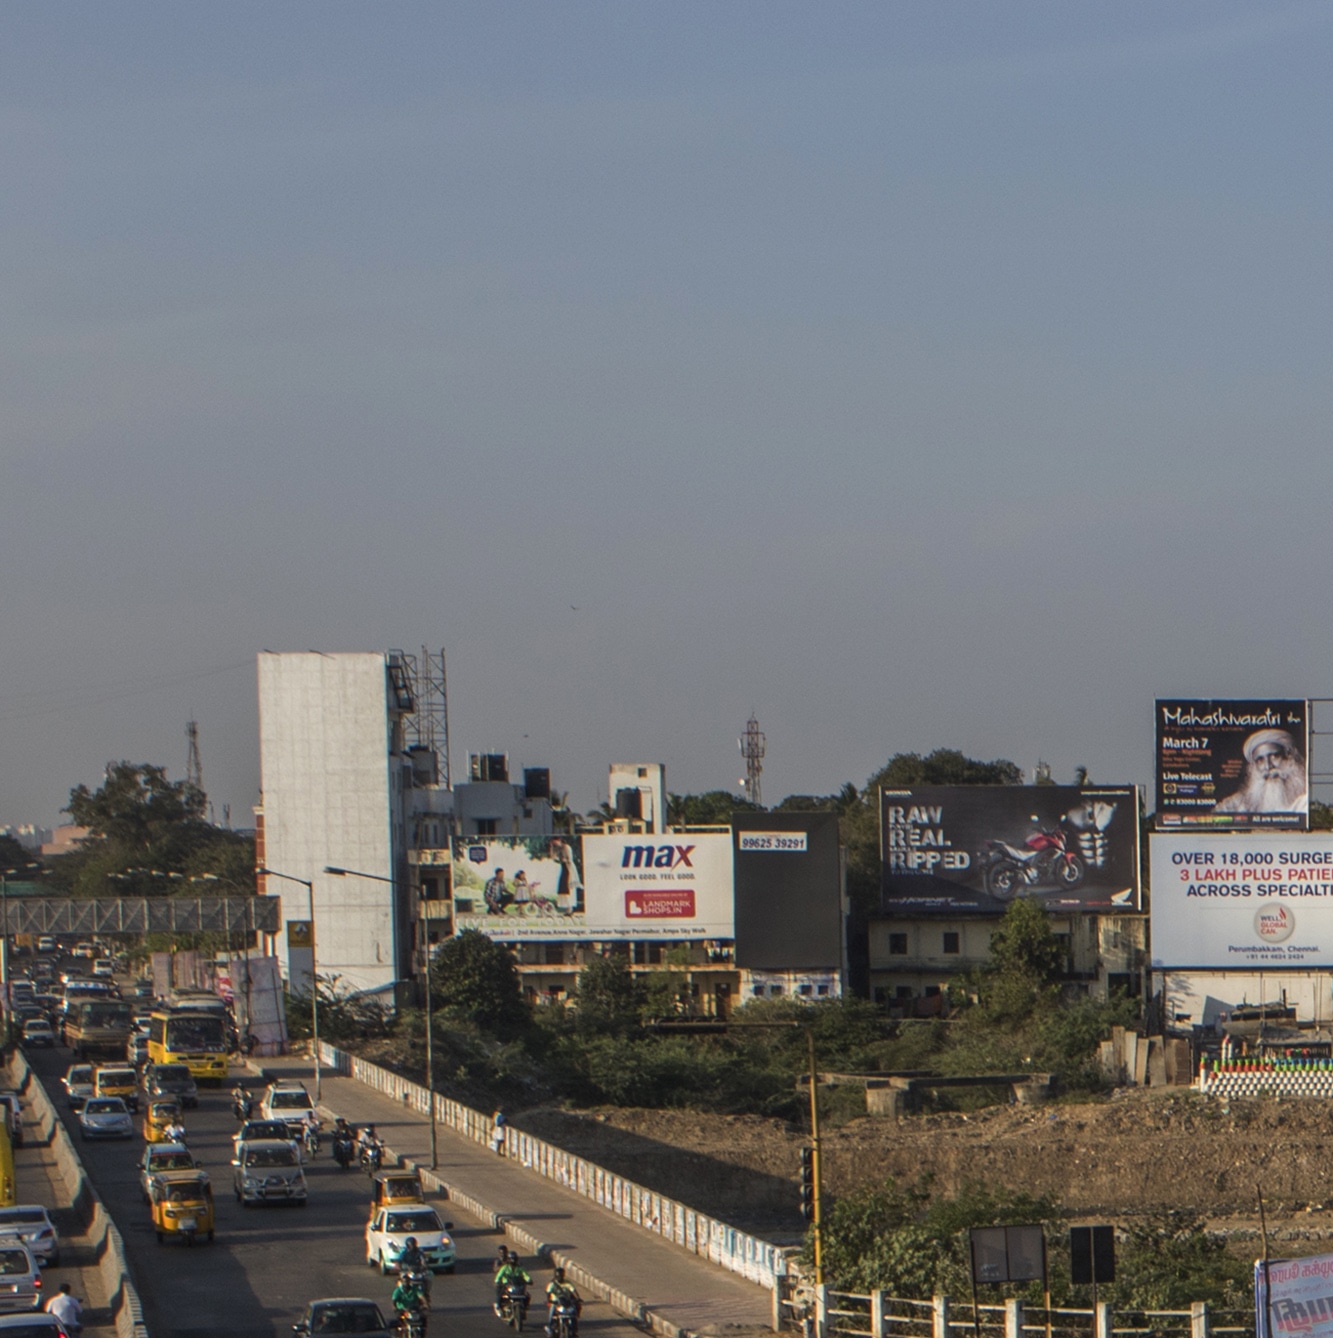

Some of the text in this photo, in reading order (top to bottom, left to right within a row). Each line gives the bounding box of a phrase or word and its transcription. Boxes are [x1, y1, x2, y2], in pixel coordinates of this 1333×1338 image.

[1162, 707, 1280, 727] Mahashivaratri
[1163, 737, 1209, 749] March 7
[1163, 771, 1212, 780] Live Telecast
[888, 806, 942, 824] RAW
[775, 838, 804, 849] 39291
[621, 845, 696, 871] max
[889, 851, 971, 869] RIPPED
[1172, 852, 1214, 865] OVER
[1221, 852, 1273, 867] 18,000
[1180, 869, 1189, 881] 3
[1195, 869, 1236, 881] LAKH
[1242, 869, 1282, 881] PLUS
[1187, 884, 1251, 897] ACROSS
